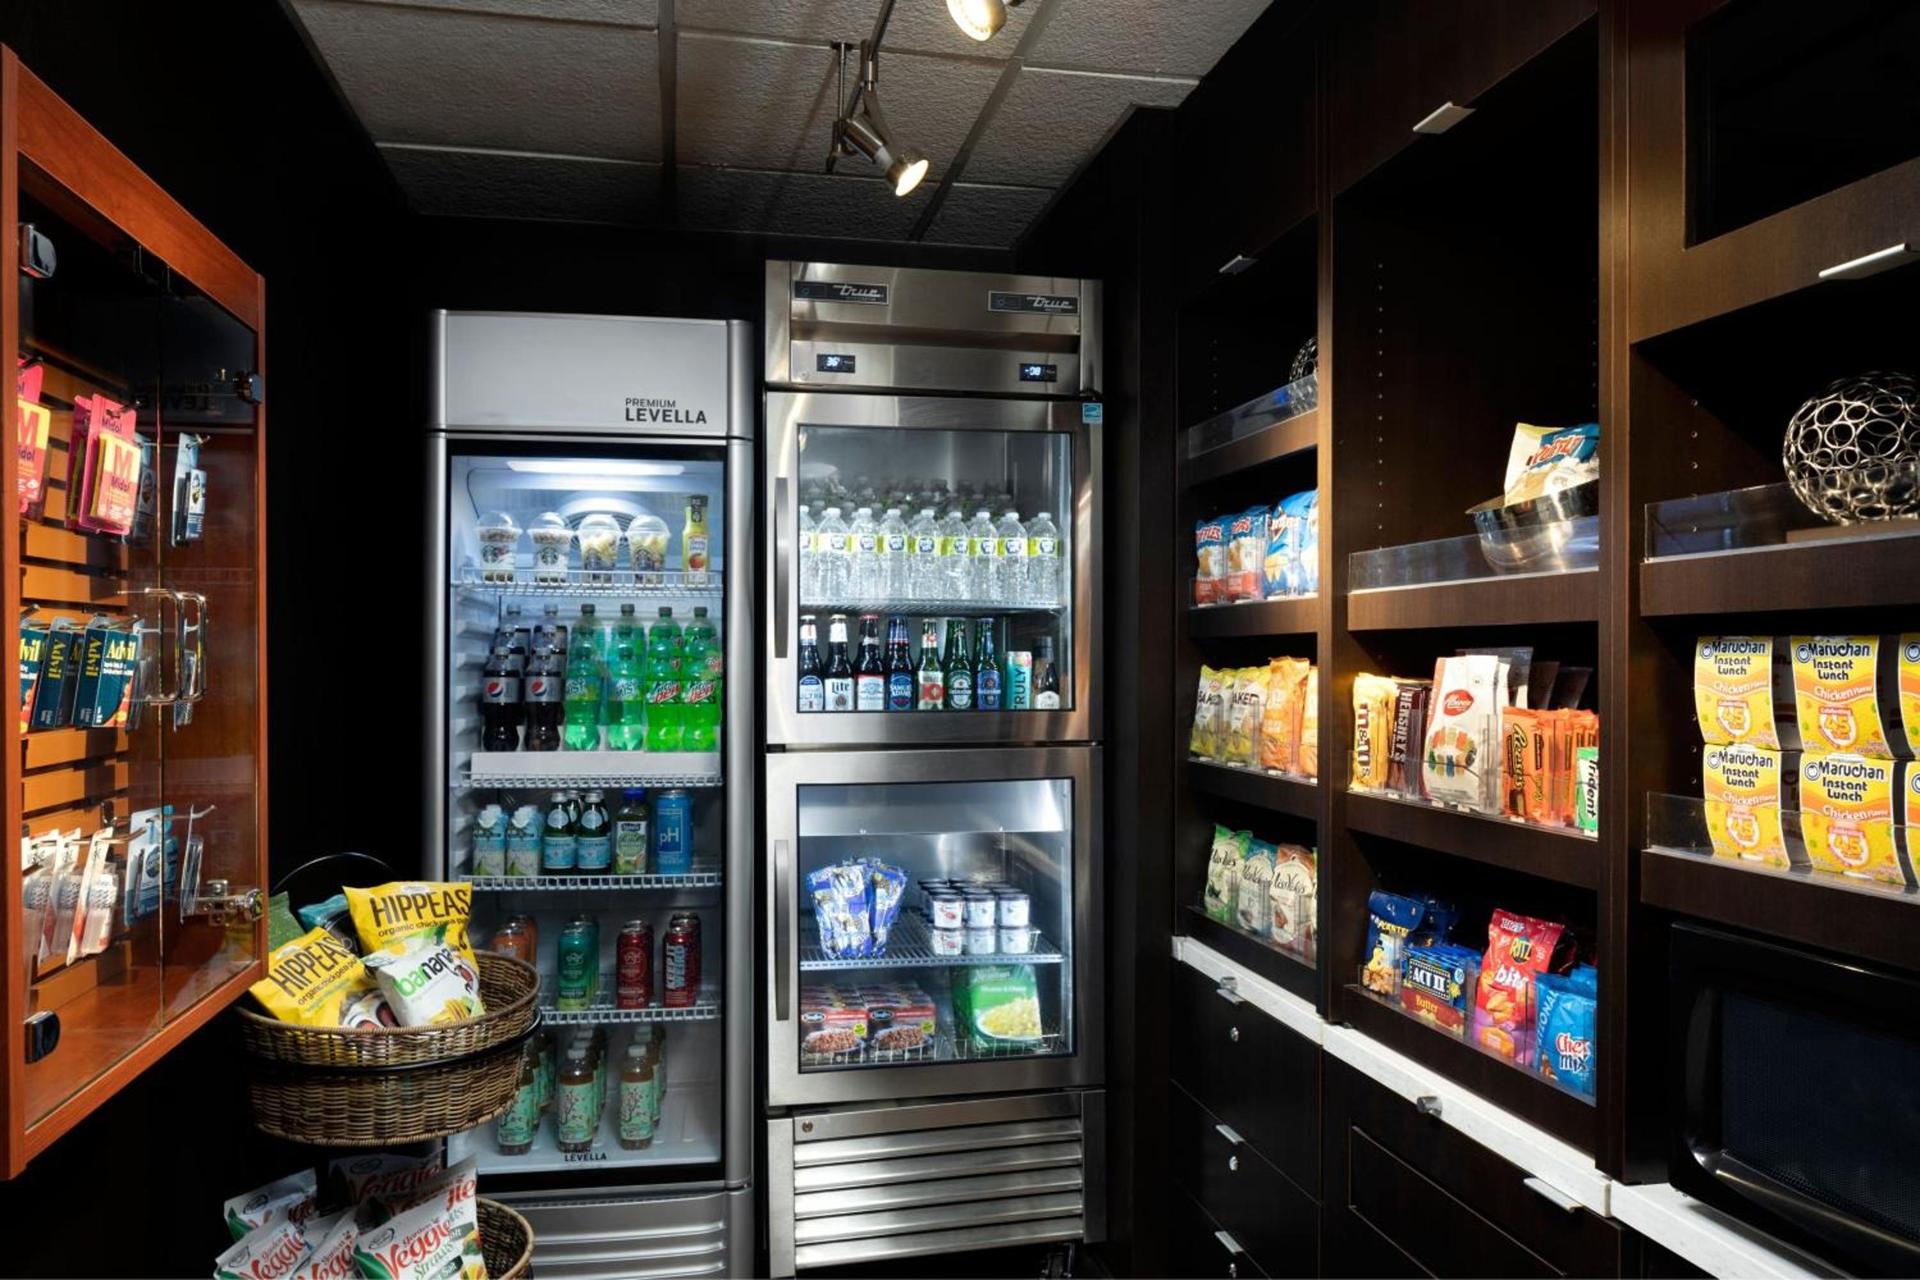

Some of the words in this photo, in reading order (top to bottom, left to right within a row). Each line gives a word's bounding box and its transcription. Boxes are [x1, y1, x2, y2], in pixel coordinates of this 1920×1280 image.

[625, 398, 676, 408] PREMIUM
[625, 408, 707, 424] LEVELLA
[17, 447, 35, 461] idol
[114, 443, 134, 479] M
[107, 639, 136, 661] Advil
[1712, 641, 1765, 653] Maruchan
[1808, 643, 1870, 656] Maruchan
[48, 638, 66, 679] Advil
[85, 636, 102, 677] Advil
[1714, 655, 1751, 666] Instant
[1718, 665, 1747, 675] Lunch
[1814, 659, 1853, 670] Instant
[1818, 670, 1849, 680] Lunch
[831, 682, 849, 694] Lite
[1814, 686, 1854, 700] Chicken
[1719, 751, 1773, 768] Maruchan
[1722, 765, 1759, 778] Instant
[1818, 761, 1884, 780] Maruchan
[1587, 759, 1598, 818] Trident
[1726, 776, 1755, 788] Lunch
[1823, 777, 1867, 791] Instant
[1827, 789, 1862, 802] Lunch
[1823, 805, 1867, 820] Chicken
[660, 827, 679, 846] pH
[369, 889, 471, 928] HIPPEAS
[1510, 938, 1532, 961] RITZ
[268, 935, 352, 998] HIPPEAS
[394, 945, 456, 997] barnana
[1413, 966, 1432, 987] ACT
[1432, 973, 1446, 993] II
[1556, 1032, 1592, 1055] Chex
[564, 1152, 607, 1162] LEVELLA
[375, 1219, 451, 1279] Veggie
